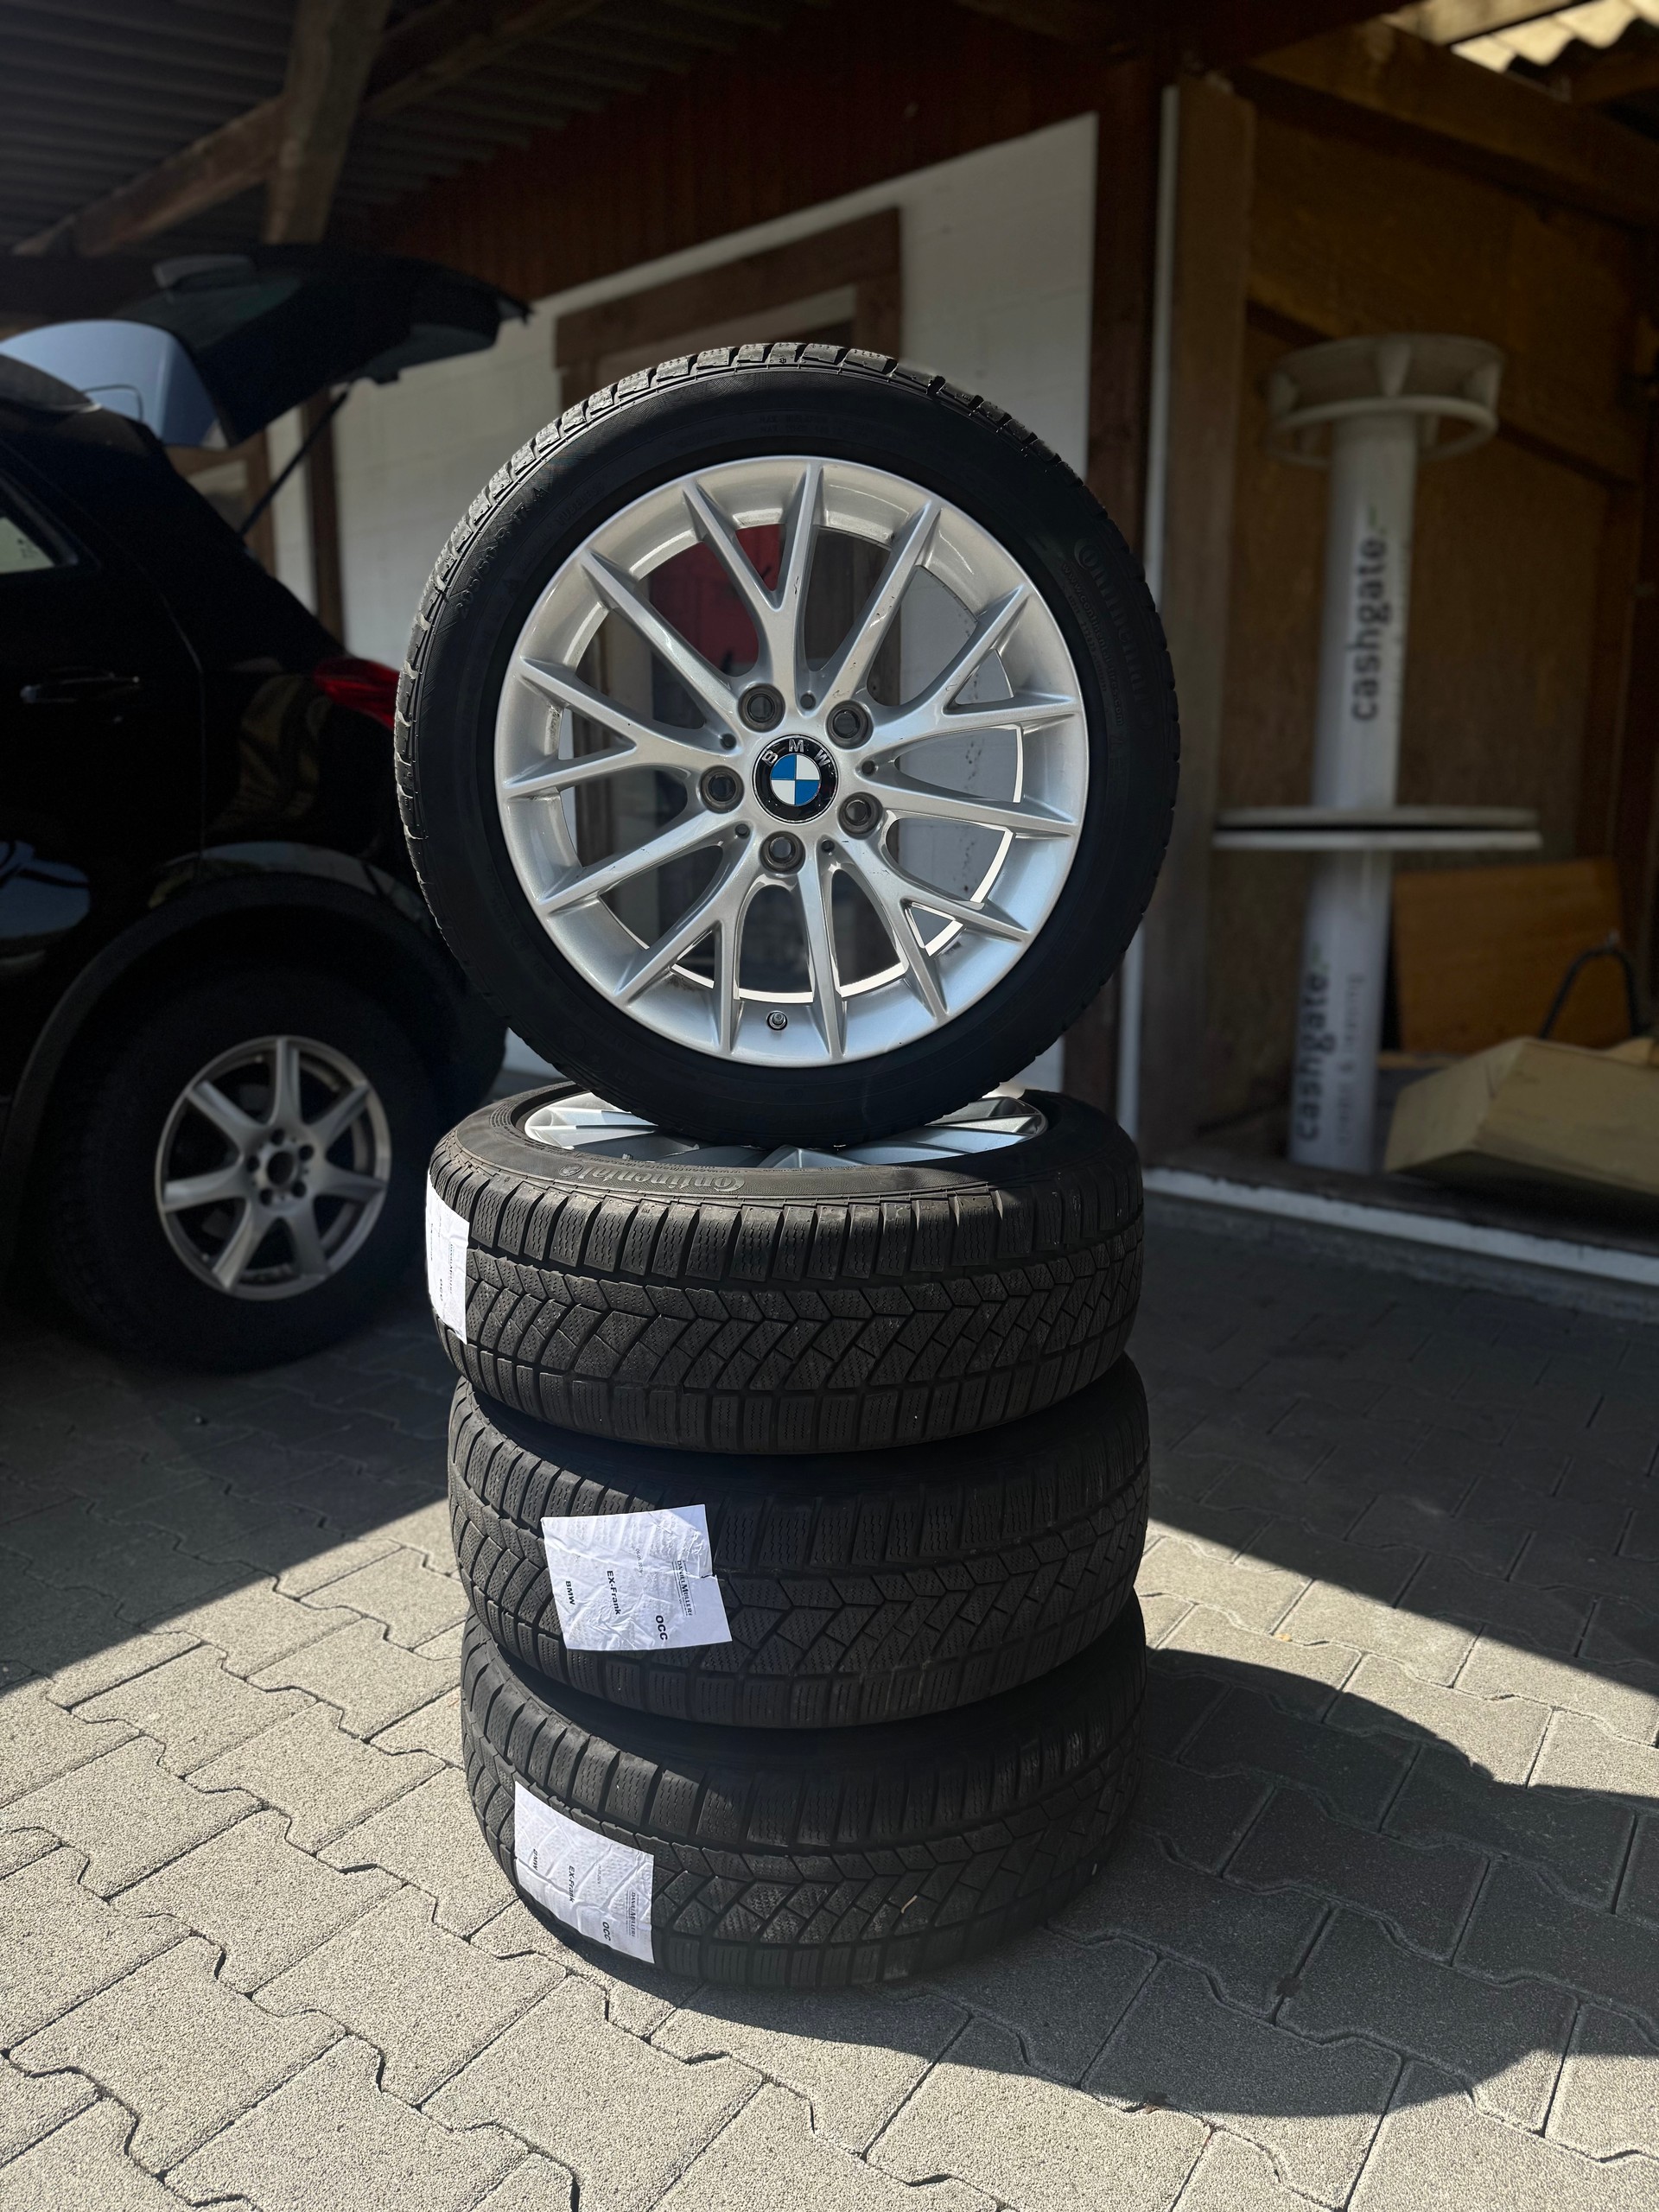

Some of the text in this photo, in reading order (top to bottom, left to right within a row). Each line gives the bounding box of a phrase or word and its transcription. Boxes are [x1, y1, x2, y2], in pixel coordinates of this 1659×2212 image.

[1073, 537, 1150, 707] Continental
[1345, 537, 1392, 721] cashgate
[761, 738, 831, 767] BMW
[1296, 973, 1335, 1141] cashgate
[577, 1166, 746, 1192] Continental
[565, 1580, 575, 1606] BMW
[607, 1569, 621, 1616] EX-Frank
[655, 1614, 668, 1641] OCC
[602, 1920, 612, 1942] OCC
